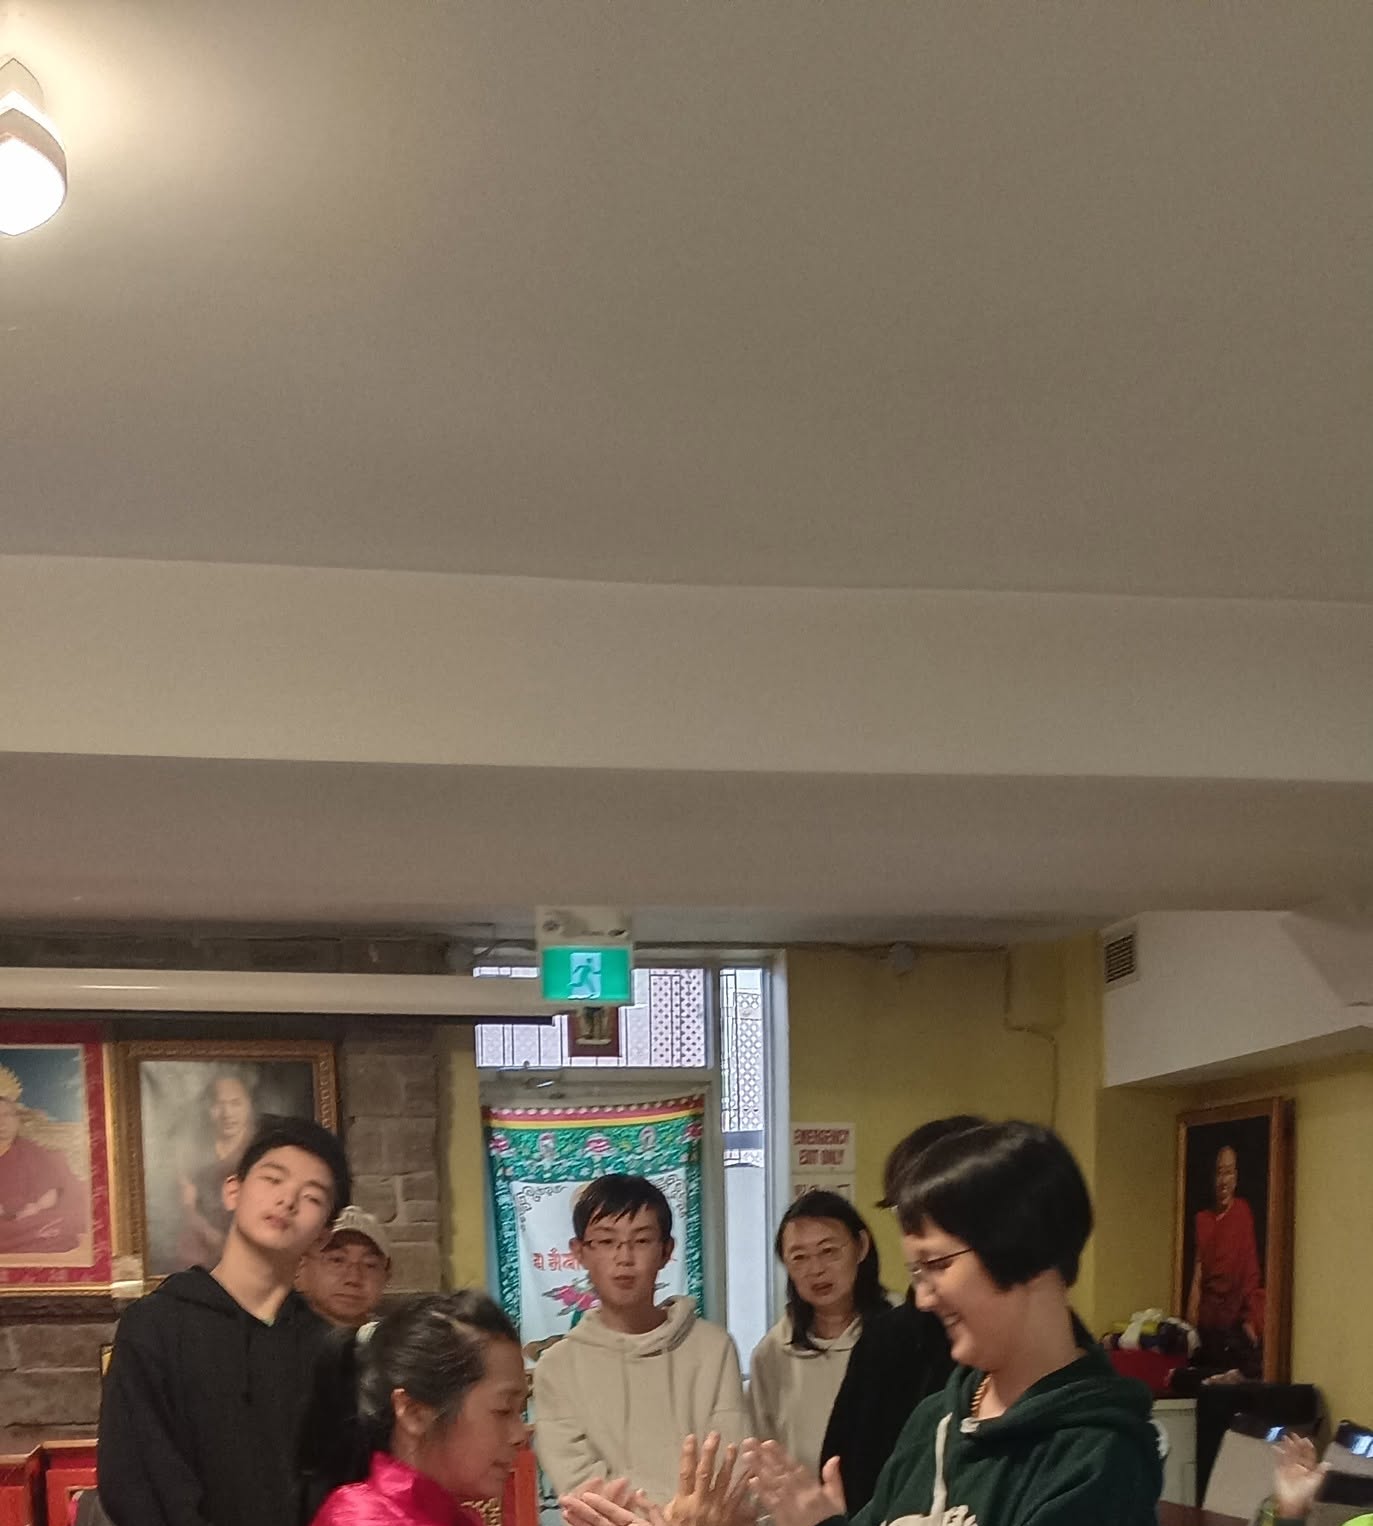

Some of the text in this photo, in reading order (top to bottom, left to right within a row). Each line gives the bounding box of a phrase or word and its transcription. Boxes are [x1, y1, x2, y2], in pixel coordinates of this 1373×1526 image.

[794, 1129, 849, 1146] EMERGENCY
[799, 1149, 845, 1165] EXIT ONLY
